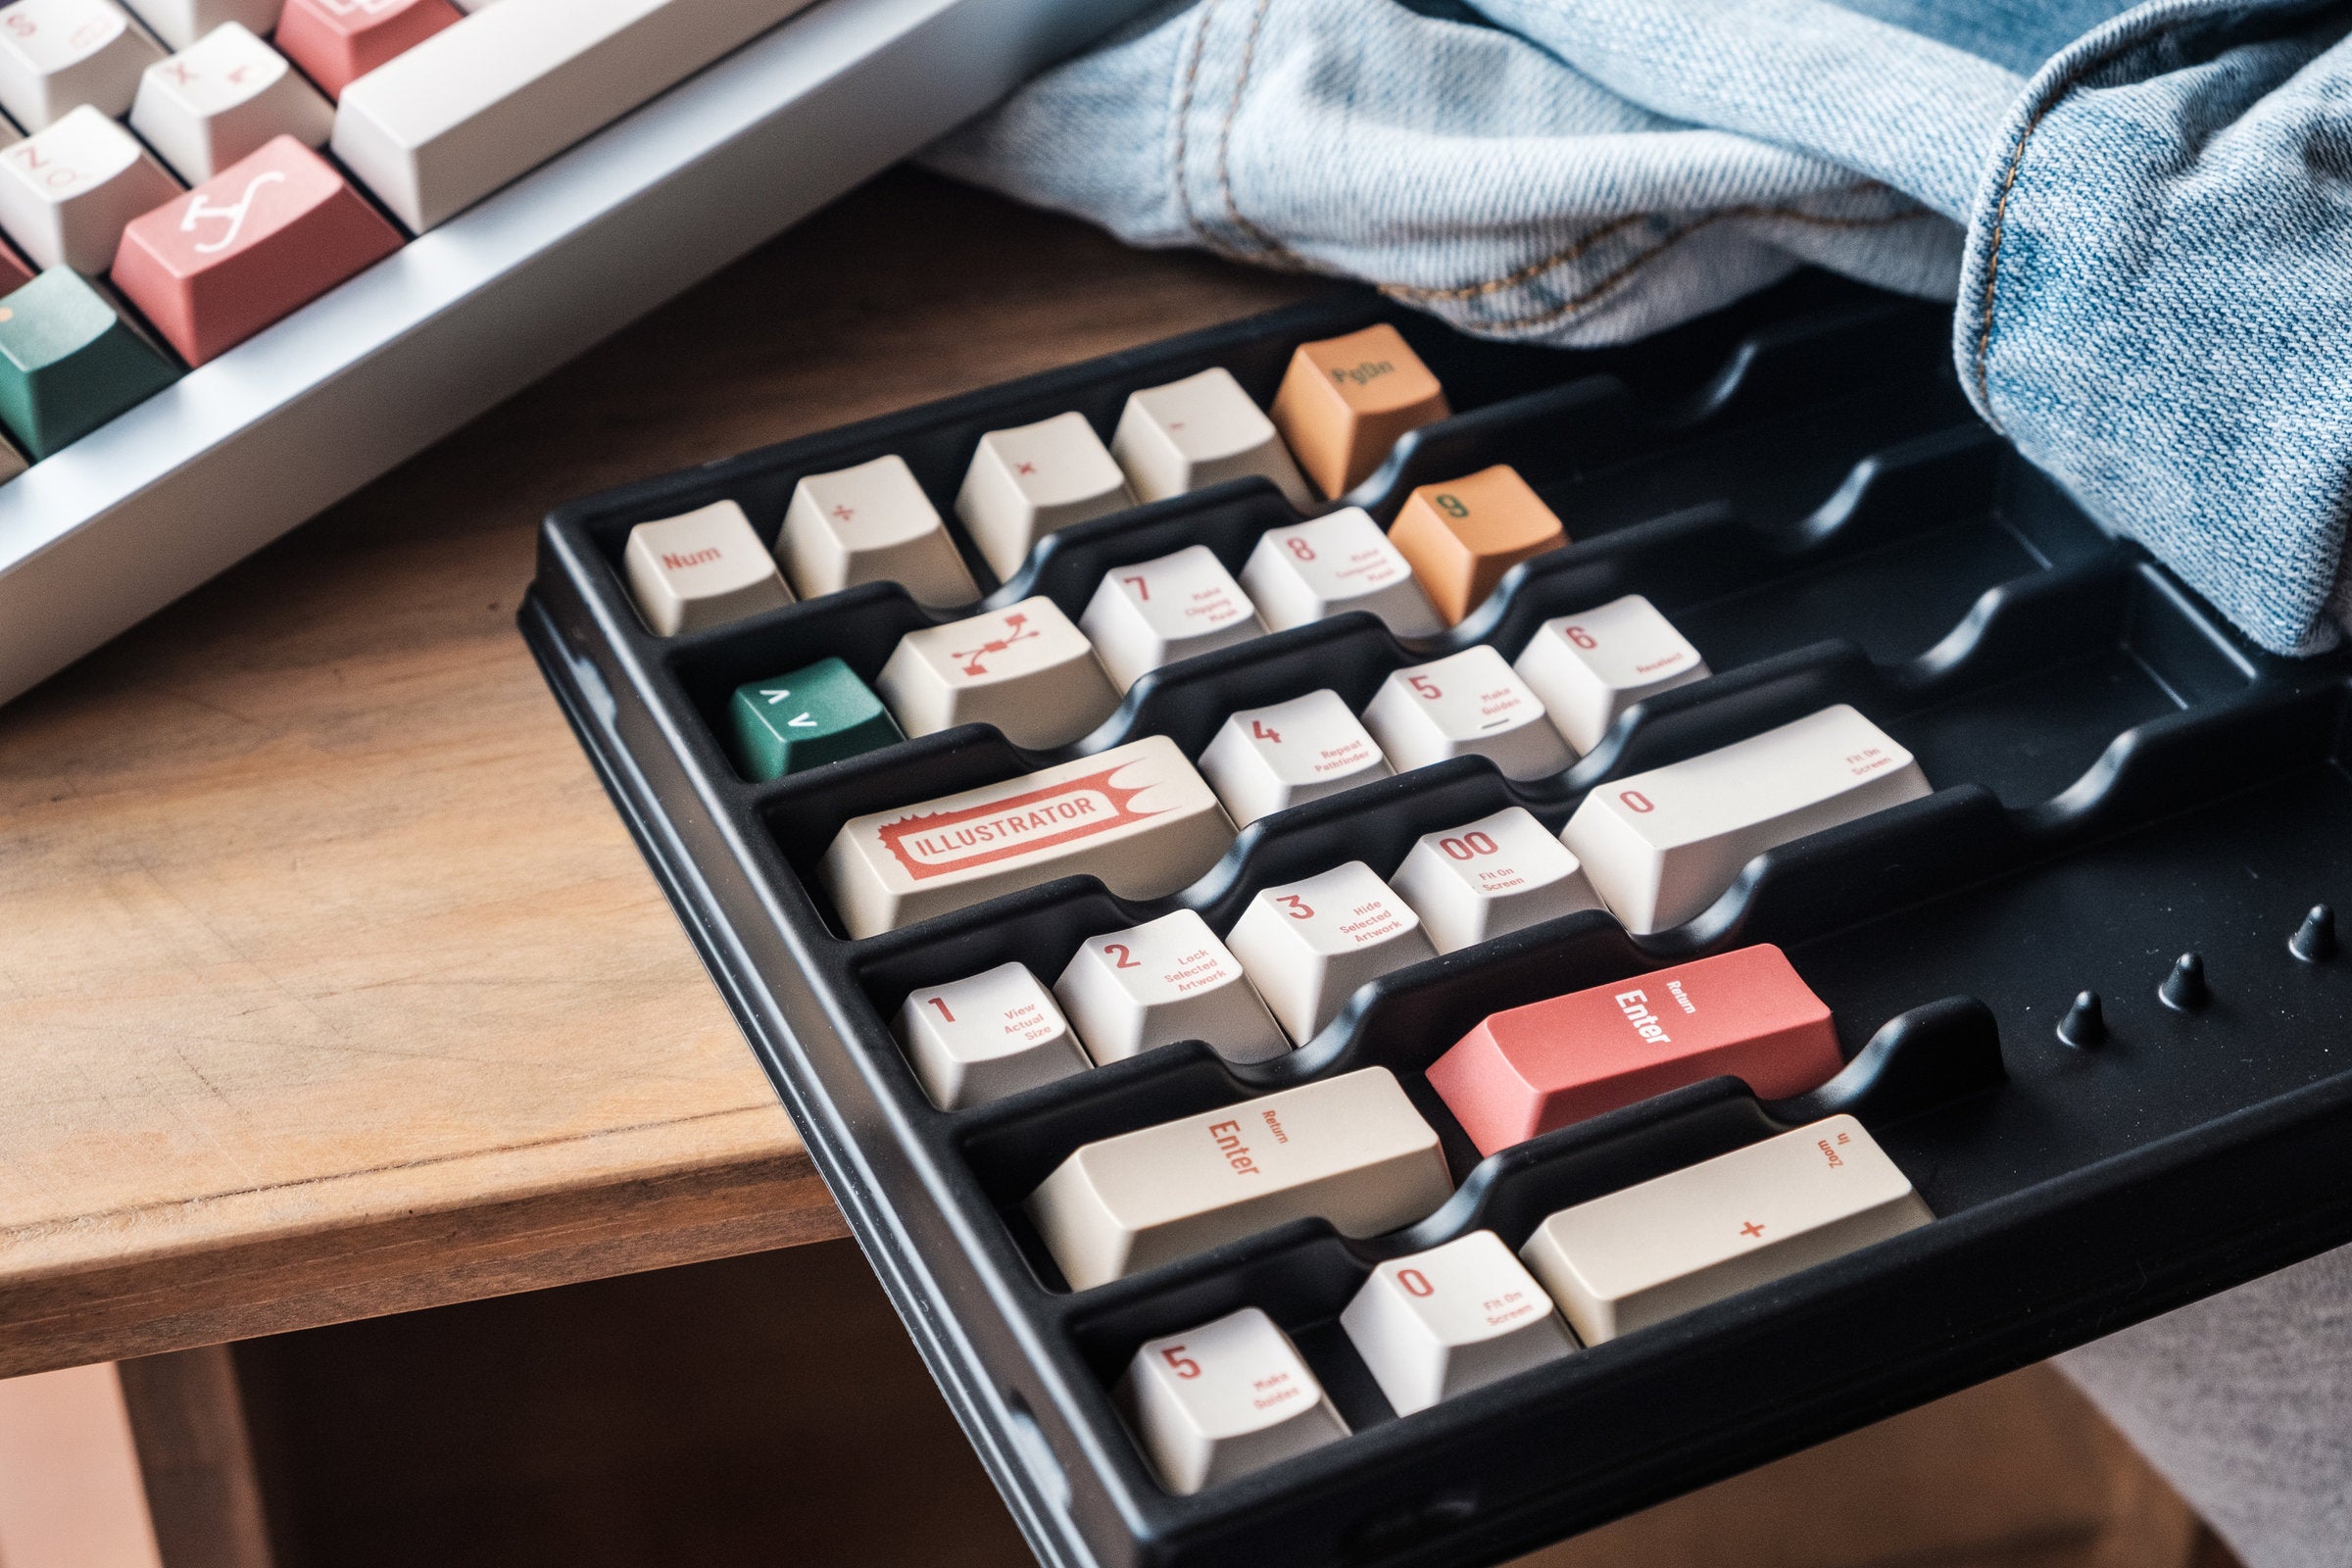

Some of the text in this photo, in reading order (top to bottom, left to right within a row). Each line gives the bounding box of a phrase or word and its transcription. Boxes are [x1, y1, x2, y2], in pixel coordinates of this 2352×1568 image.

[7, 14, 37, 38] S
[166, 62, 197, 84] X
[17, 146, 49, 169] Z
[1332, 362, 1395, 385] PgDn
[1436, 494, 1469, 518] 9
[662, 546, 721, 570] Num
[1287, 537, 1317, 562] 8
[1124, 576, 1150, 602] 7
[1566, 626, 1598, 651] 6
[1408, 676, 1443, 701] 5
[1481, 688, 1511, 702] Make
[1482, 698, 1521, 714] Guides
[1251, 720, 1282, 744] 4
[1320, 740, 1362, 759] Repeat
[1314, 751, 1370, 772] Pathfinder
[1851, 758, 1891, 775] Screen
[1619, 790, 1654, 813] 0
[914, 797, 1097, 858] ILLUSTRATOR
[1439, 831, 1498, 861] 00
[1482, 878, 1525, 892] Screen
[1276, 894, 1315, 919] 3
[1353, 901, 1382, 915] Hide
[1339, 909, 1392, 933] Selected
[1354, 921, 1402, 942] Artwork
[1103, 944, 1141, 968] 2
[1178, 950, 1209, 965] Lock
[1163, 958, 1217, 983] Selected
[1178, 970, 1227, 992] Artwork
[1667, 980, 1695, 1014] Return
[927, 998, 956, 1022] 1
[1004, 1004, 1036, 1019] View
[1614, 989, 1671, 1044] Enter
[1004, 1013, 1045, 1034] Actual
[1024, 1026, 1052, 1040] Size
[1261, 1109, 1289, 1144] Return
[1208, 1119, 1259, 1176] Enter
[1837, 1132, 1851, 1145] In
[1817, 1139, 1844, 1169] Zoom
[1396, 1269, 1435, 1298] 0
[1483, 1292, 1523, 1311] Fit On
[1487, 1304, 1535, 1326] Screen
[1160, 1346, 1201, 1380] 5
[1253, 1373, 1289, 1391] Make
[1253, 1388, 1299, 1411] Guides
